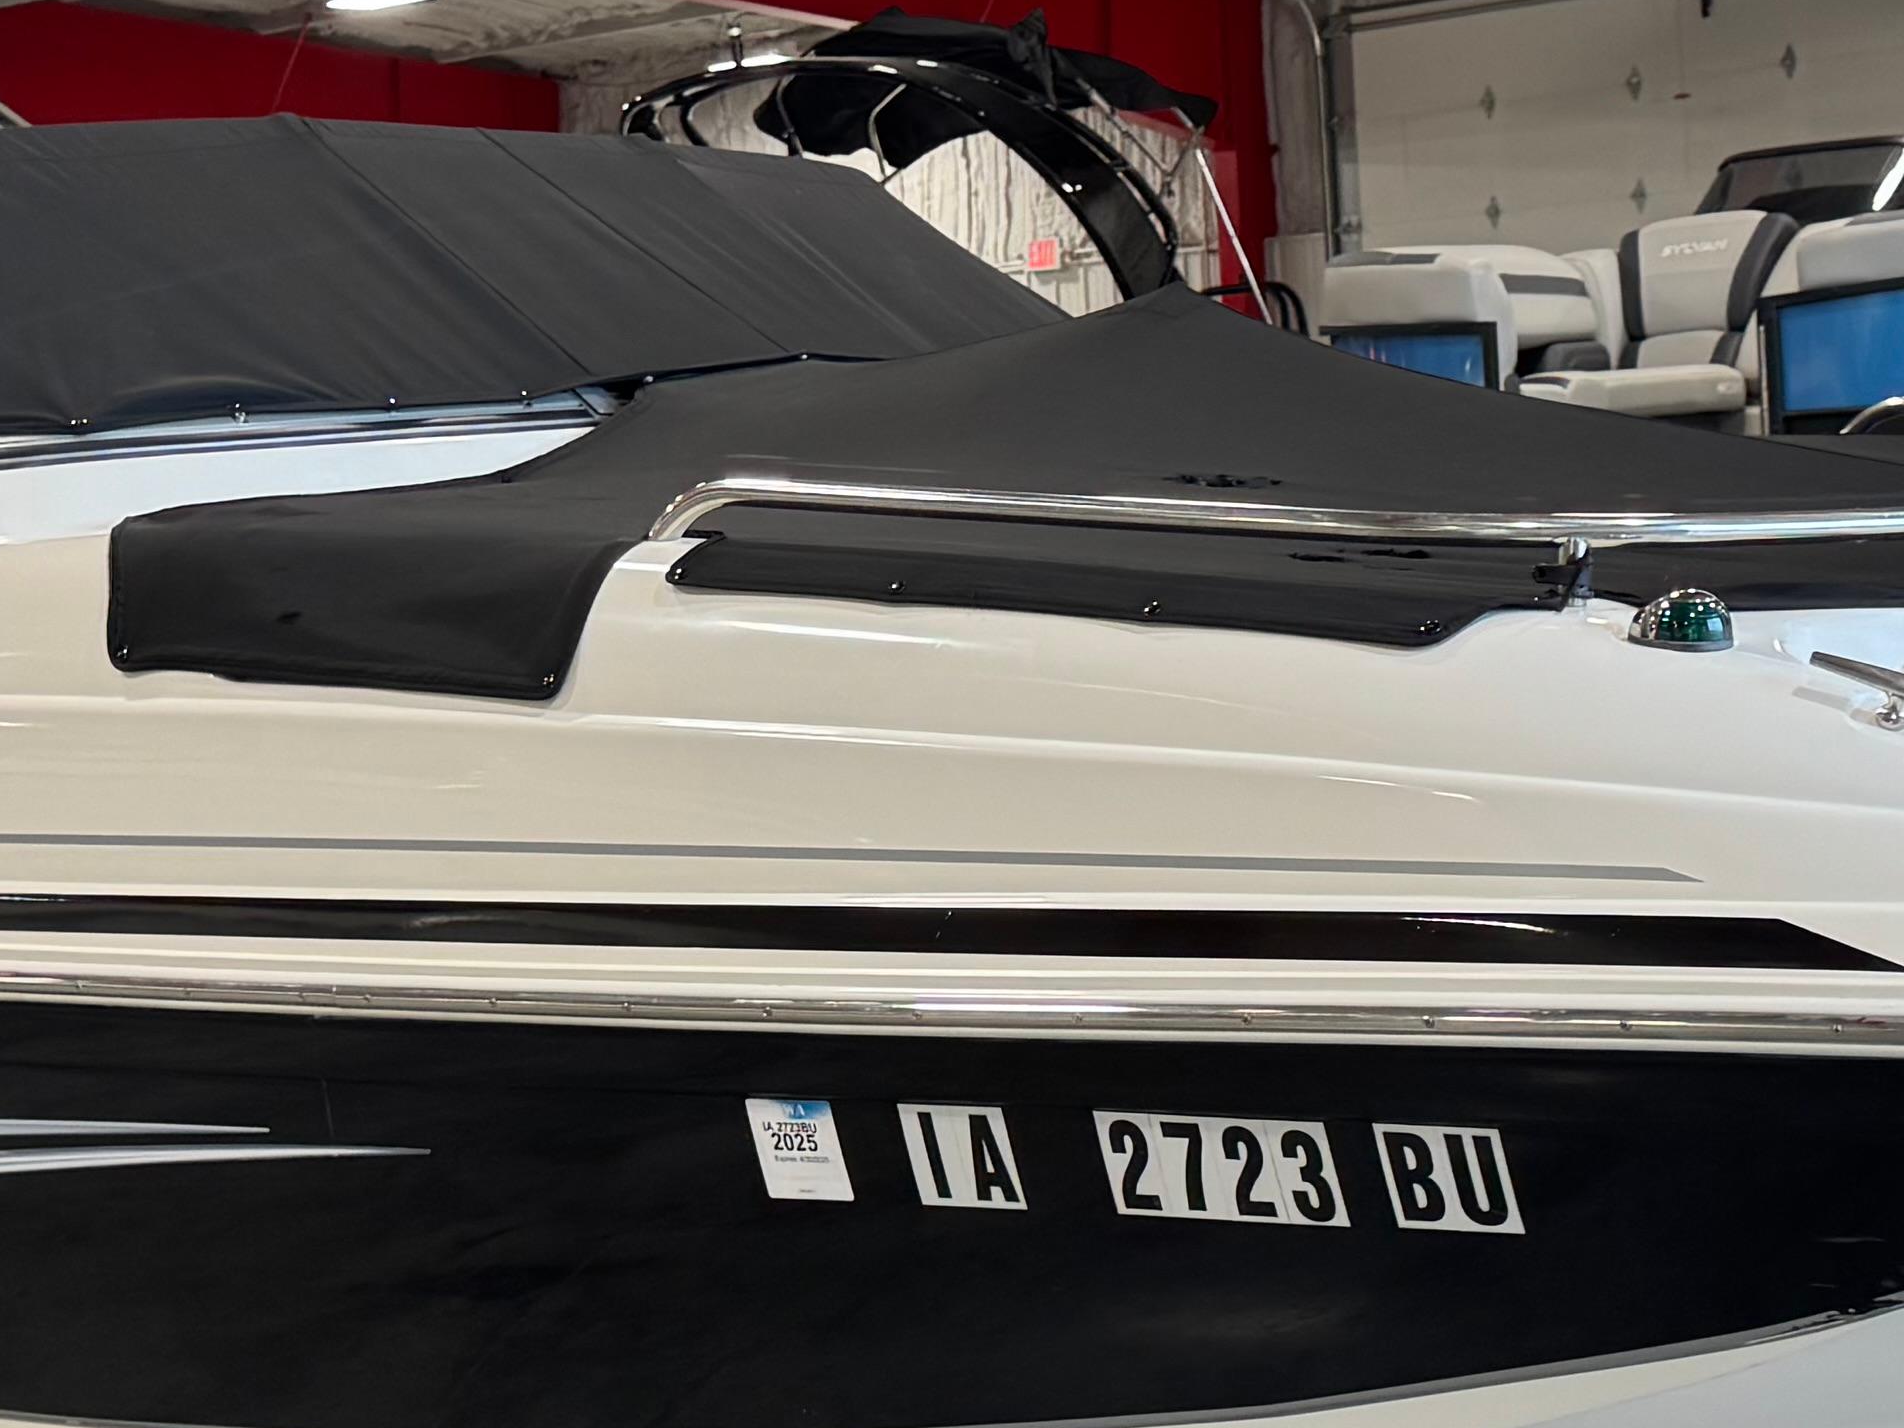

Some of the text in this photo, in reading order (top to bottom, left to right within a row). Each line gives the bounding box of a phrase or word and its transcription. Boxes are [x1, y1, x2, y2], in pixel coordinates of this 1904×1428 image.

[771, 1132, 819, 1153] 2025
[916, 1111, 1509, 1227] IA 2723 BU
